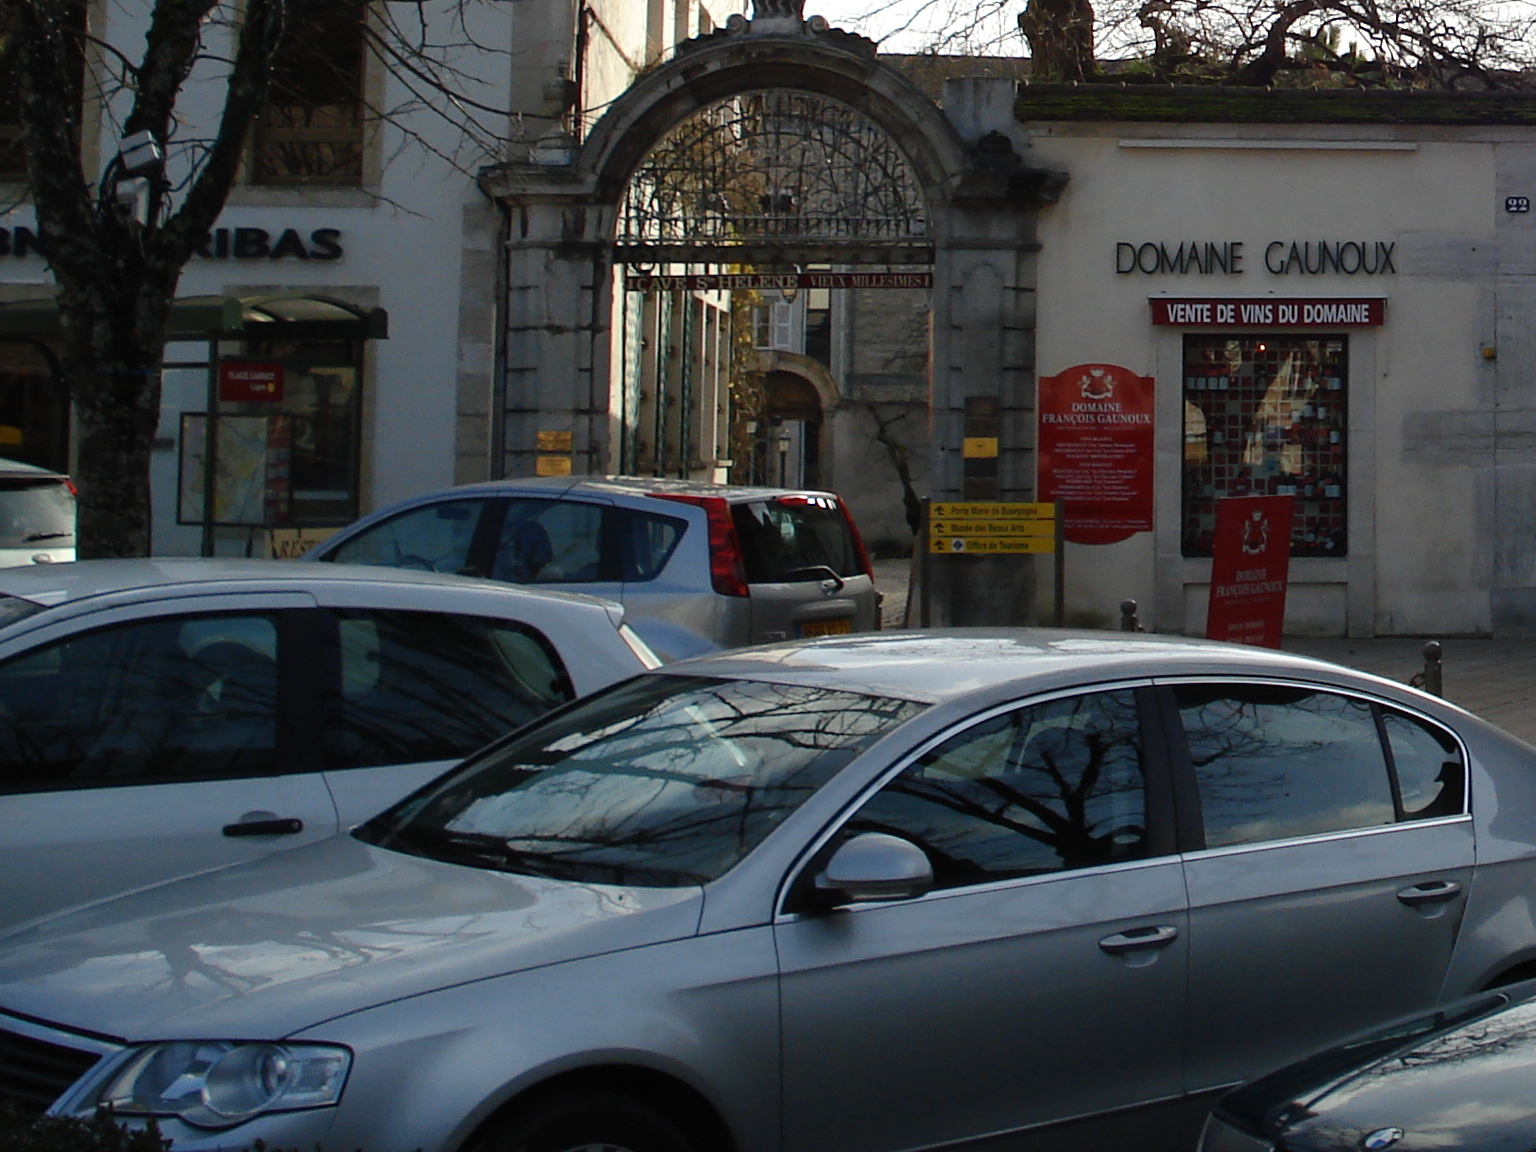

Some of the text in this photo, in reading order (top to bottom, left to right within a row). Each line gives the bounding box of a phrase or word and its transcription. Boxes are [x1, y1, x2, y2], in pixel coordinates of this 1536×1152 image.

[1507, 198, 1528, 212] 22
[1115, 240, 1397, 275] DOMAINE GAUNOUX
[637, 276, 687, 291] CAVE
[809, 274, 846, 288] VIEUX
[1166, 303, 1370, 324] VENTE DE VINS DU DOMAINE
[1071, 402, 1122, 413] DOMAINE
[1042, 413, 1151, 425] FRANÇOIS GAUNOUX
